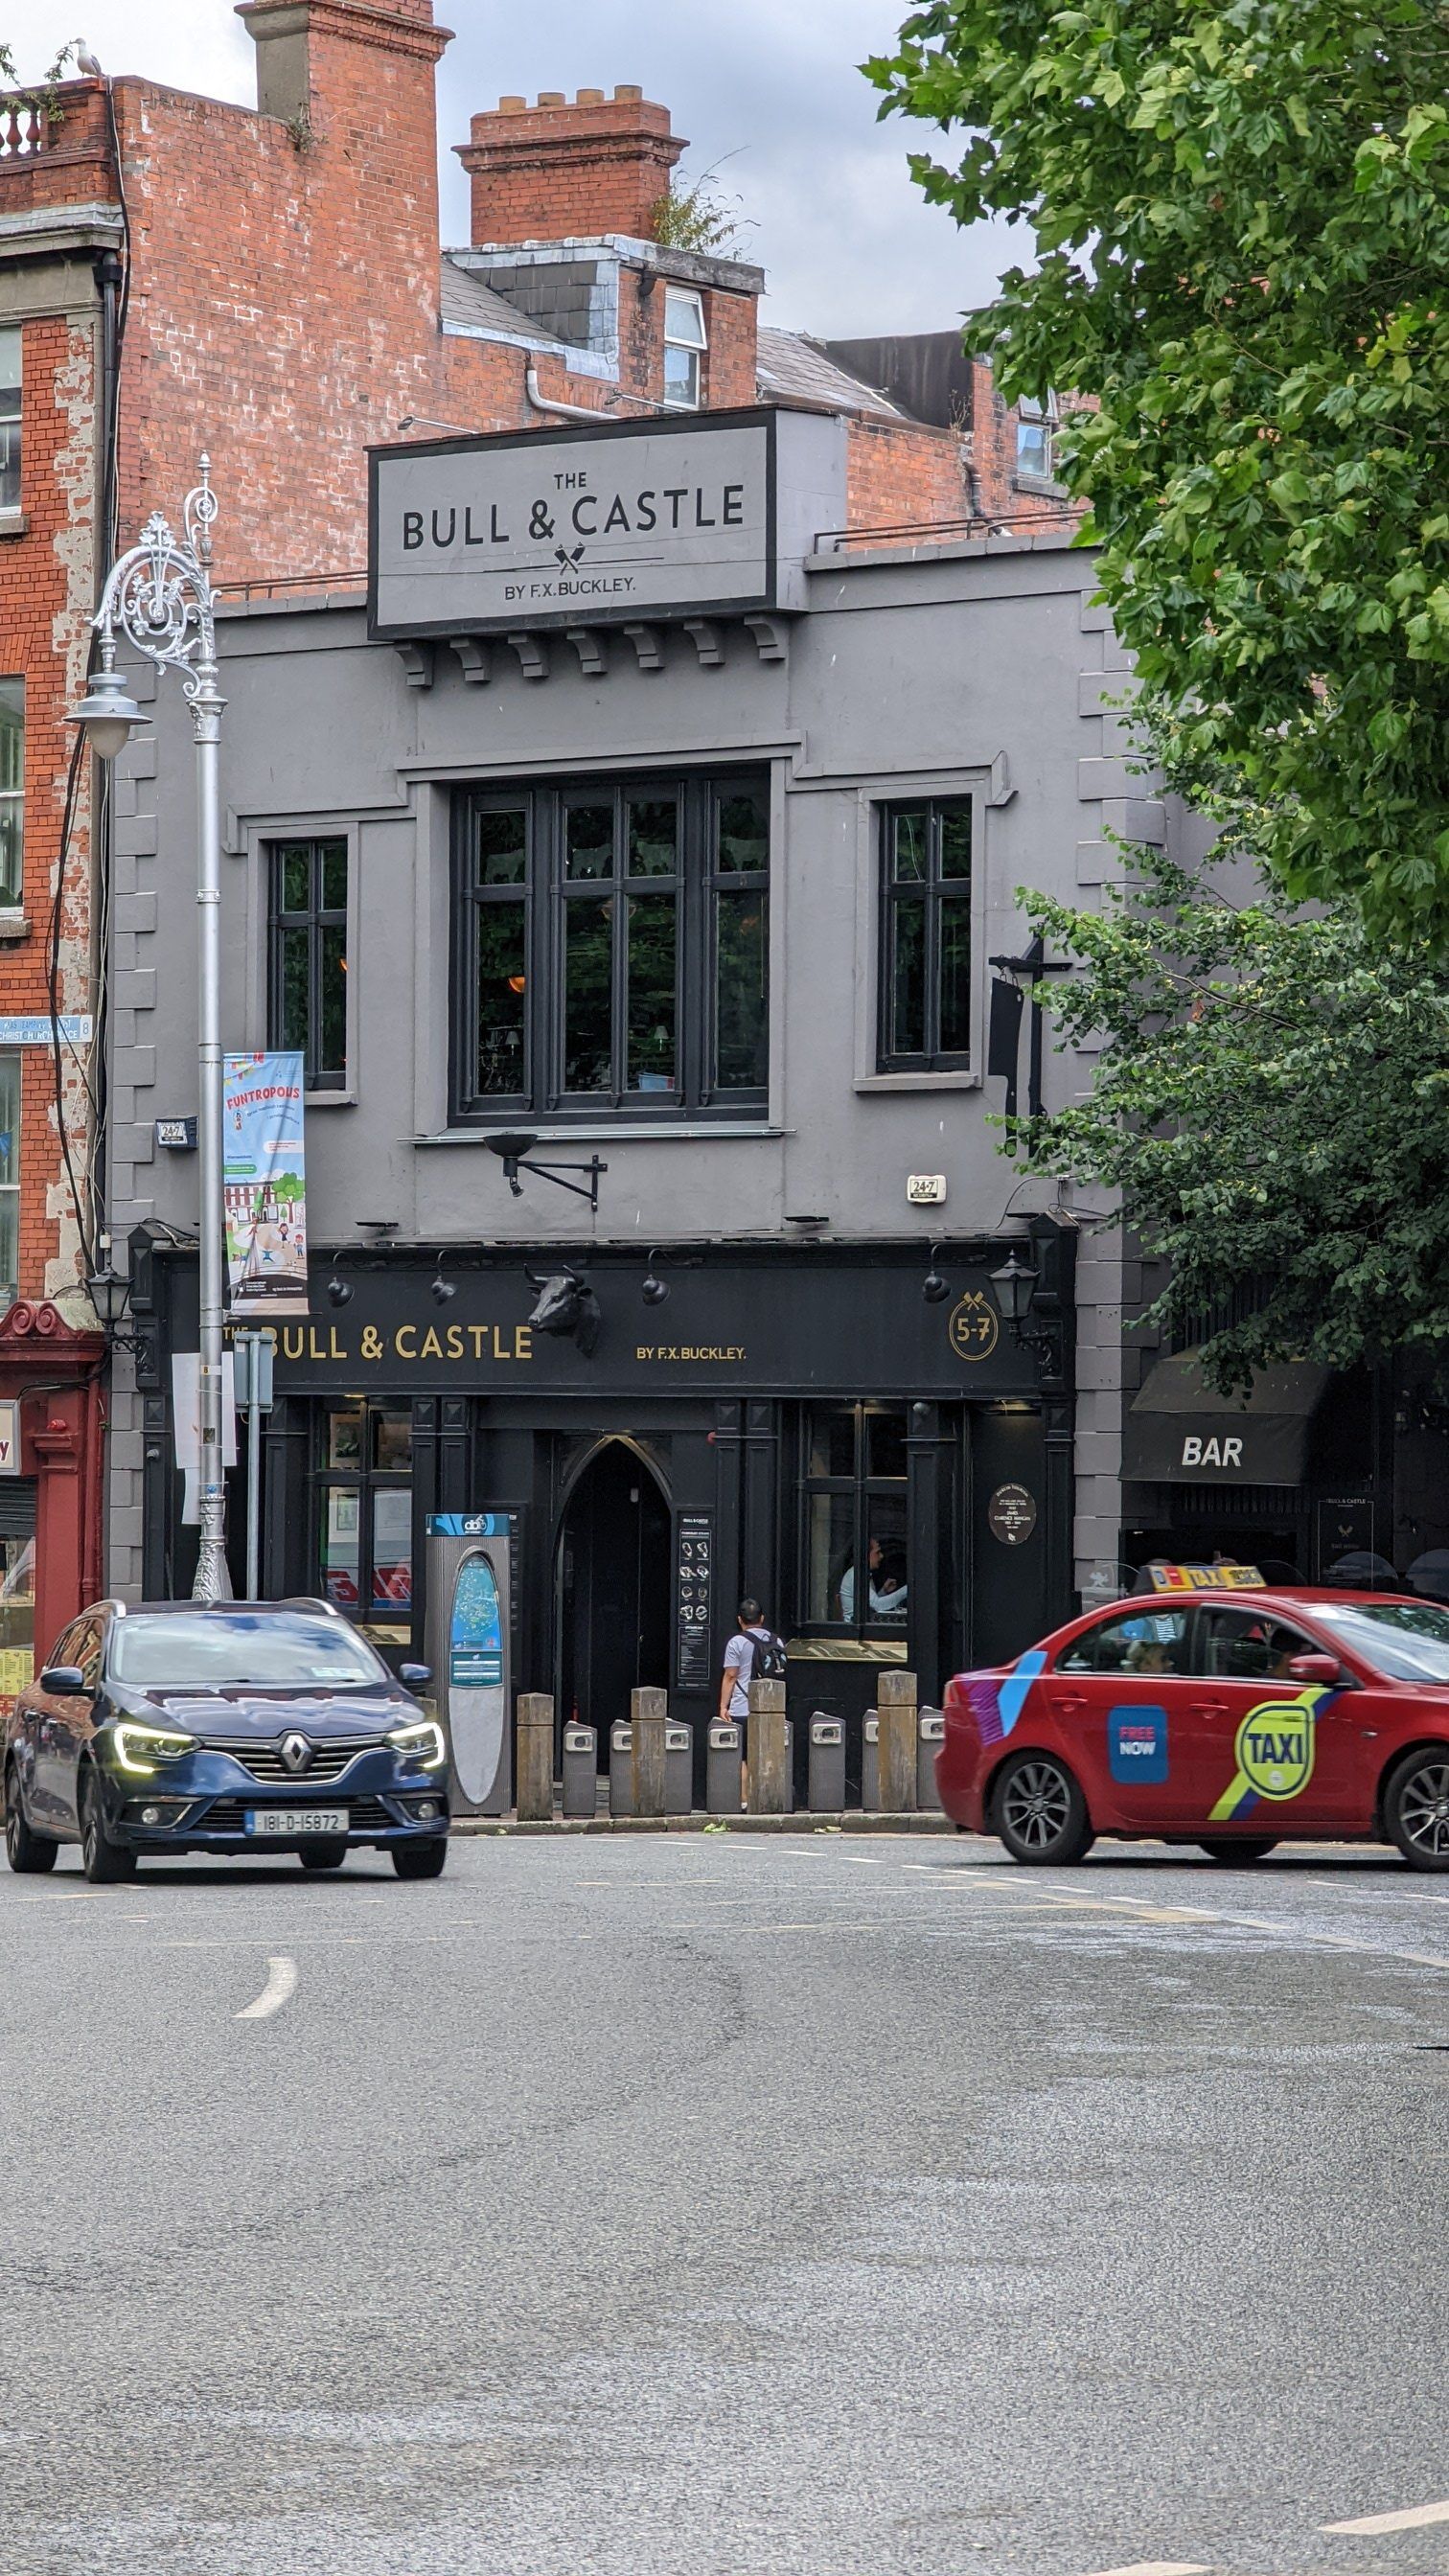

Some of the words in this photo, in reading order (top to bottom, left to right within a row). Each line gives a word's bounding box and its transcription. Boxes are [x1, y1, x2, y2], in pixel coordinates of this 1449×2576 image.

[554, 472, 586, 490] THE
[403, 504, 510, 550] BULL
[529, 499, 556, 540] &
[571, 485, 744, 536] CASTLE
[505, 586, 526, 600] BY
[82, 1023, 89, 1035] 8
[226, 1087, 300, 1110] FUNTROPOLIS
[957, 1318, 990, 1341] 5-7
[360, 1324, 383, 1359] &
[395, 1324, 533, 1359] CASTLE
[636, 1347, 655, 1359] BY
[1182, 1437, 1243, 1467] BAR
[1119, 1727, 1156, 1740] FREE
[1119, 1741, 1157, 1755] NOW
[1247, 1734, 1303, 1764] TAXI
[264, 1815, 338, 1830] 181-D-15872
